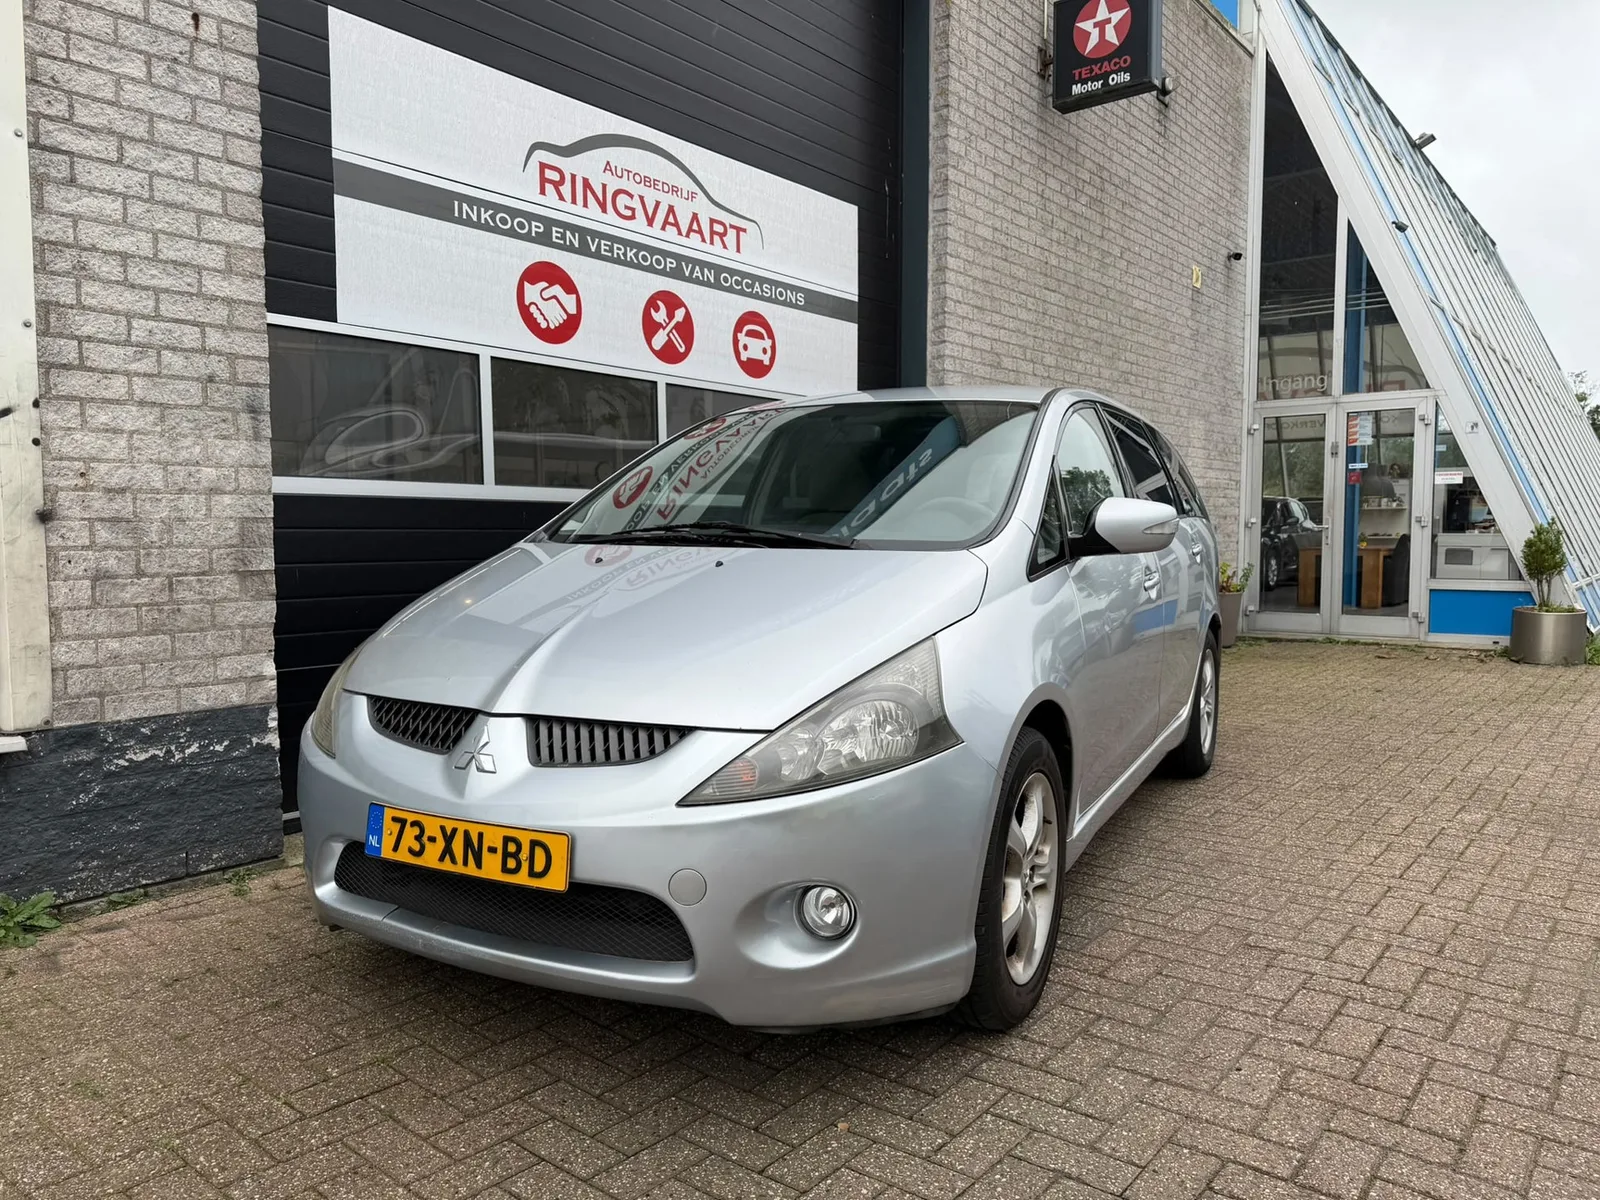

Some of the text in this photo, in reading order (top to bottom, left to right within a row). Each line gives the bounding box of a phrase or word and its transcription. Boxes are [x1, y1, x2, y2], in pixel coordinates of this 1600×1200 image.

[1071, 71, 1131, 96] Motor Oils
[1072, 55, 1132, 81] TEXACO
[602, 160, 699, 203] AUTOBEDRIJF
[538, 160, 748, 255] RINGVAART
[452, 200, 806, 306] INKOOP EN VERKOOP VAN OCCASIONS
[1262, 373, 1329, 393] Ingang
[368, 834, 380, 848] NL
[390, 815, 553, 879] 73-XN-BD
